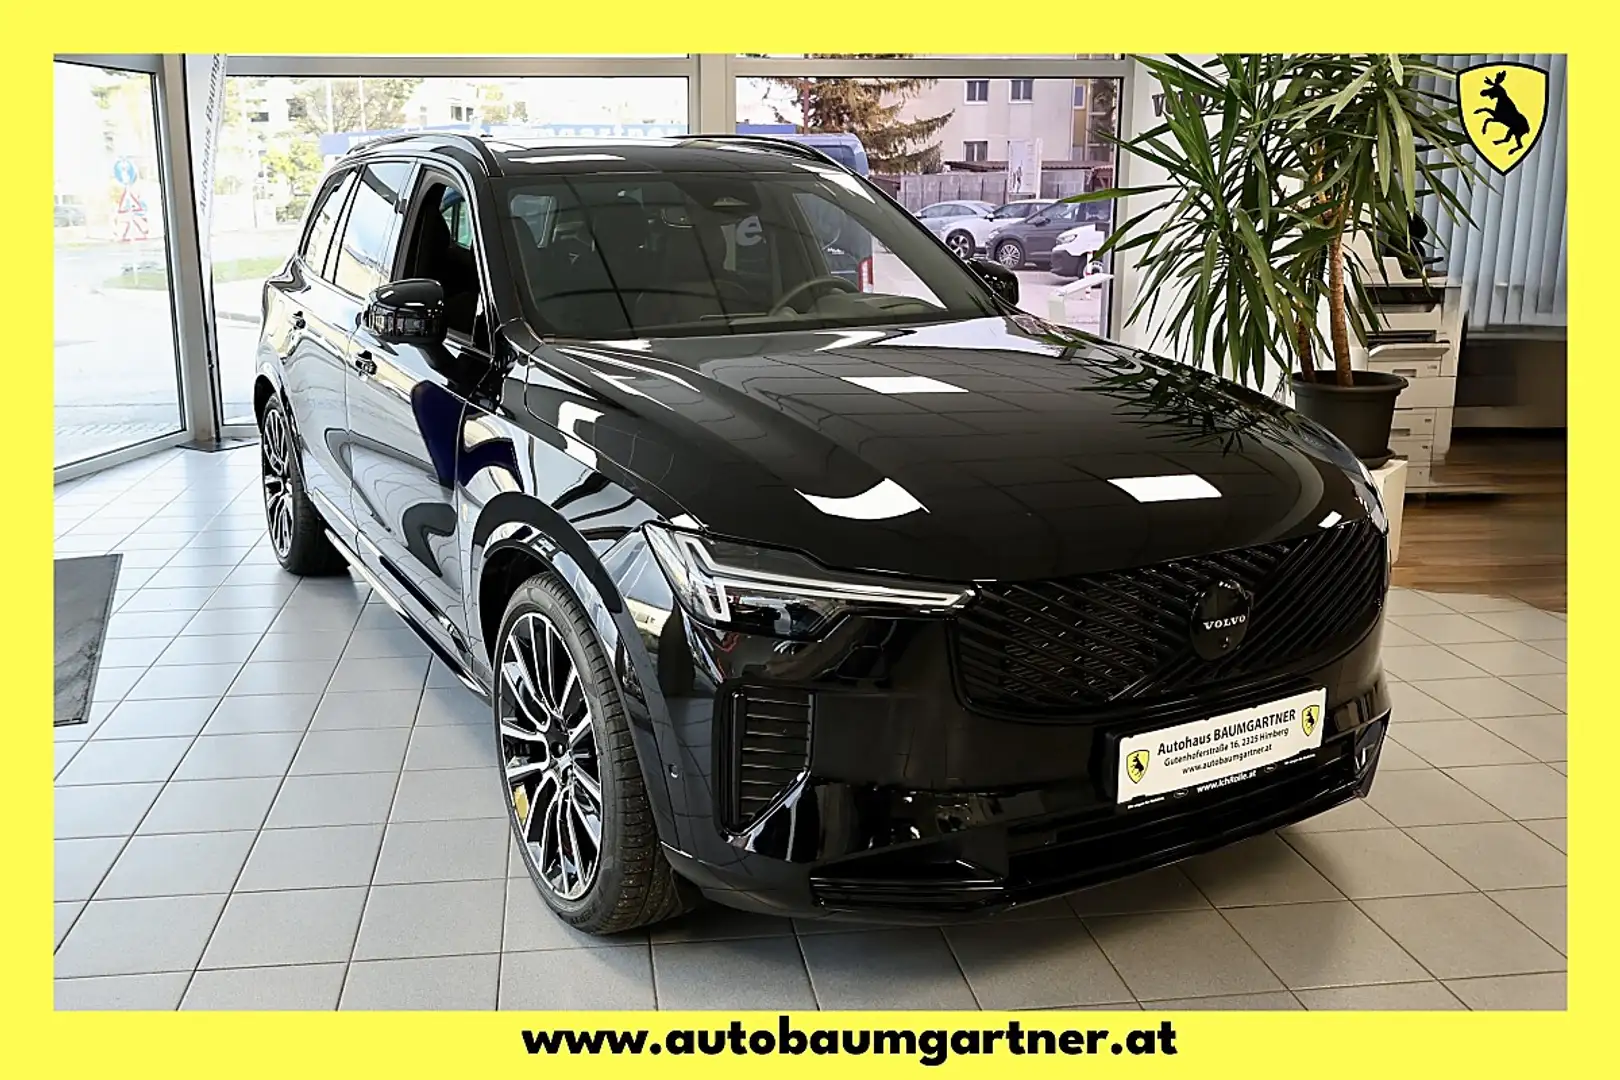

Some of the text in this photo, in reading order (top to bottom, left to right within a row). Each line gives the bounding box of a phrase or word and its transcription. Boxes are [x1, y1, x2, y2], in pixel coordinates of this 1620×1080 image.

[199, 126, 212, 216] Autohaus
[1203, 614, 1246, 630] VOLVO
[1157, 709, 1296, 756] Autohaus BAUMGARTNER
[1164, 743, 1229, 767] Gutenhoferstraße
[1242, 736, 1259, 747] 2325
[1260, 727, 1289, 742] Himberg
[1182, 744, 1272, 775] www.autobaumgartner.at
